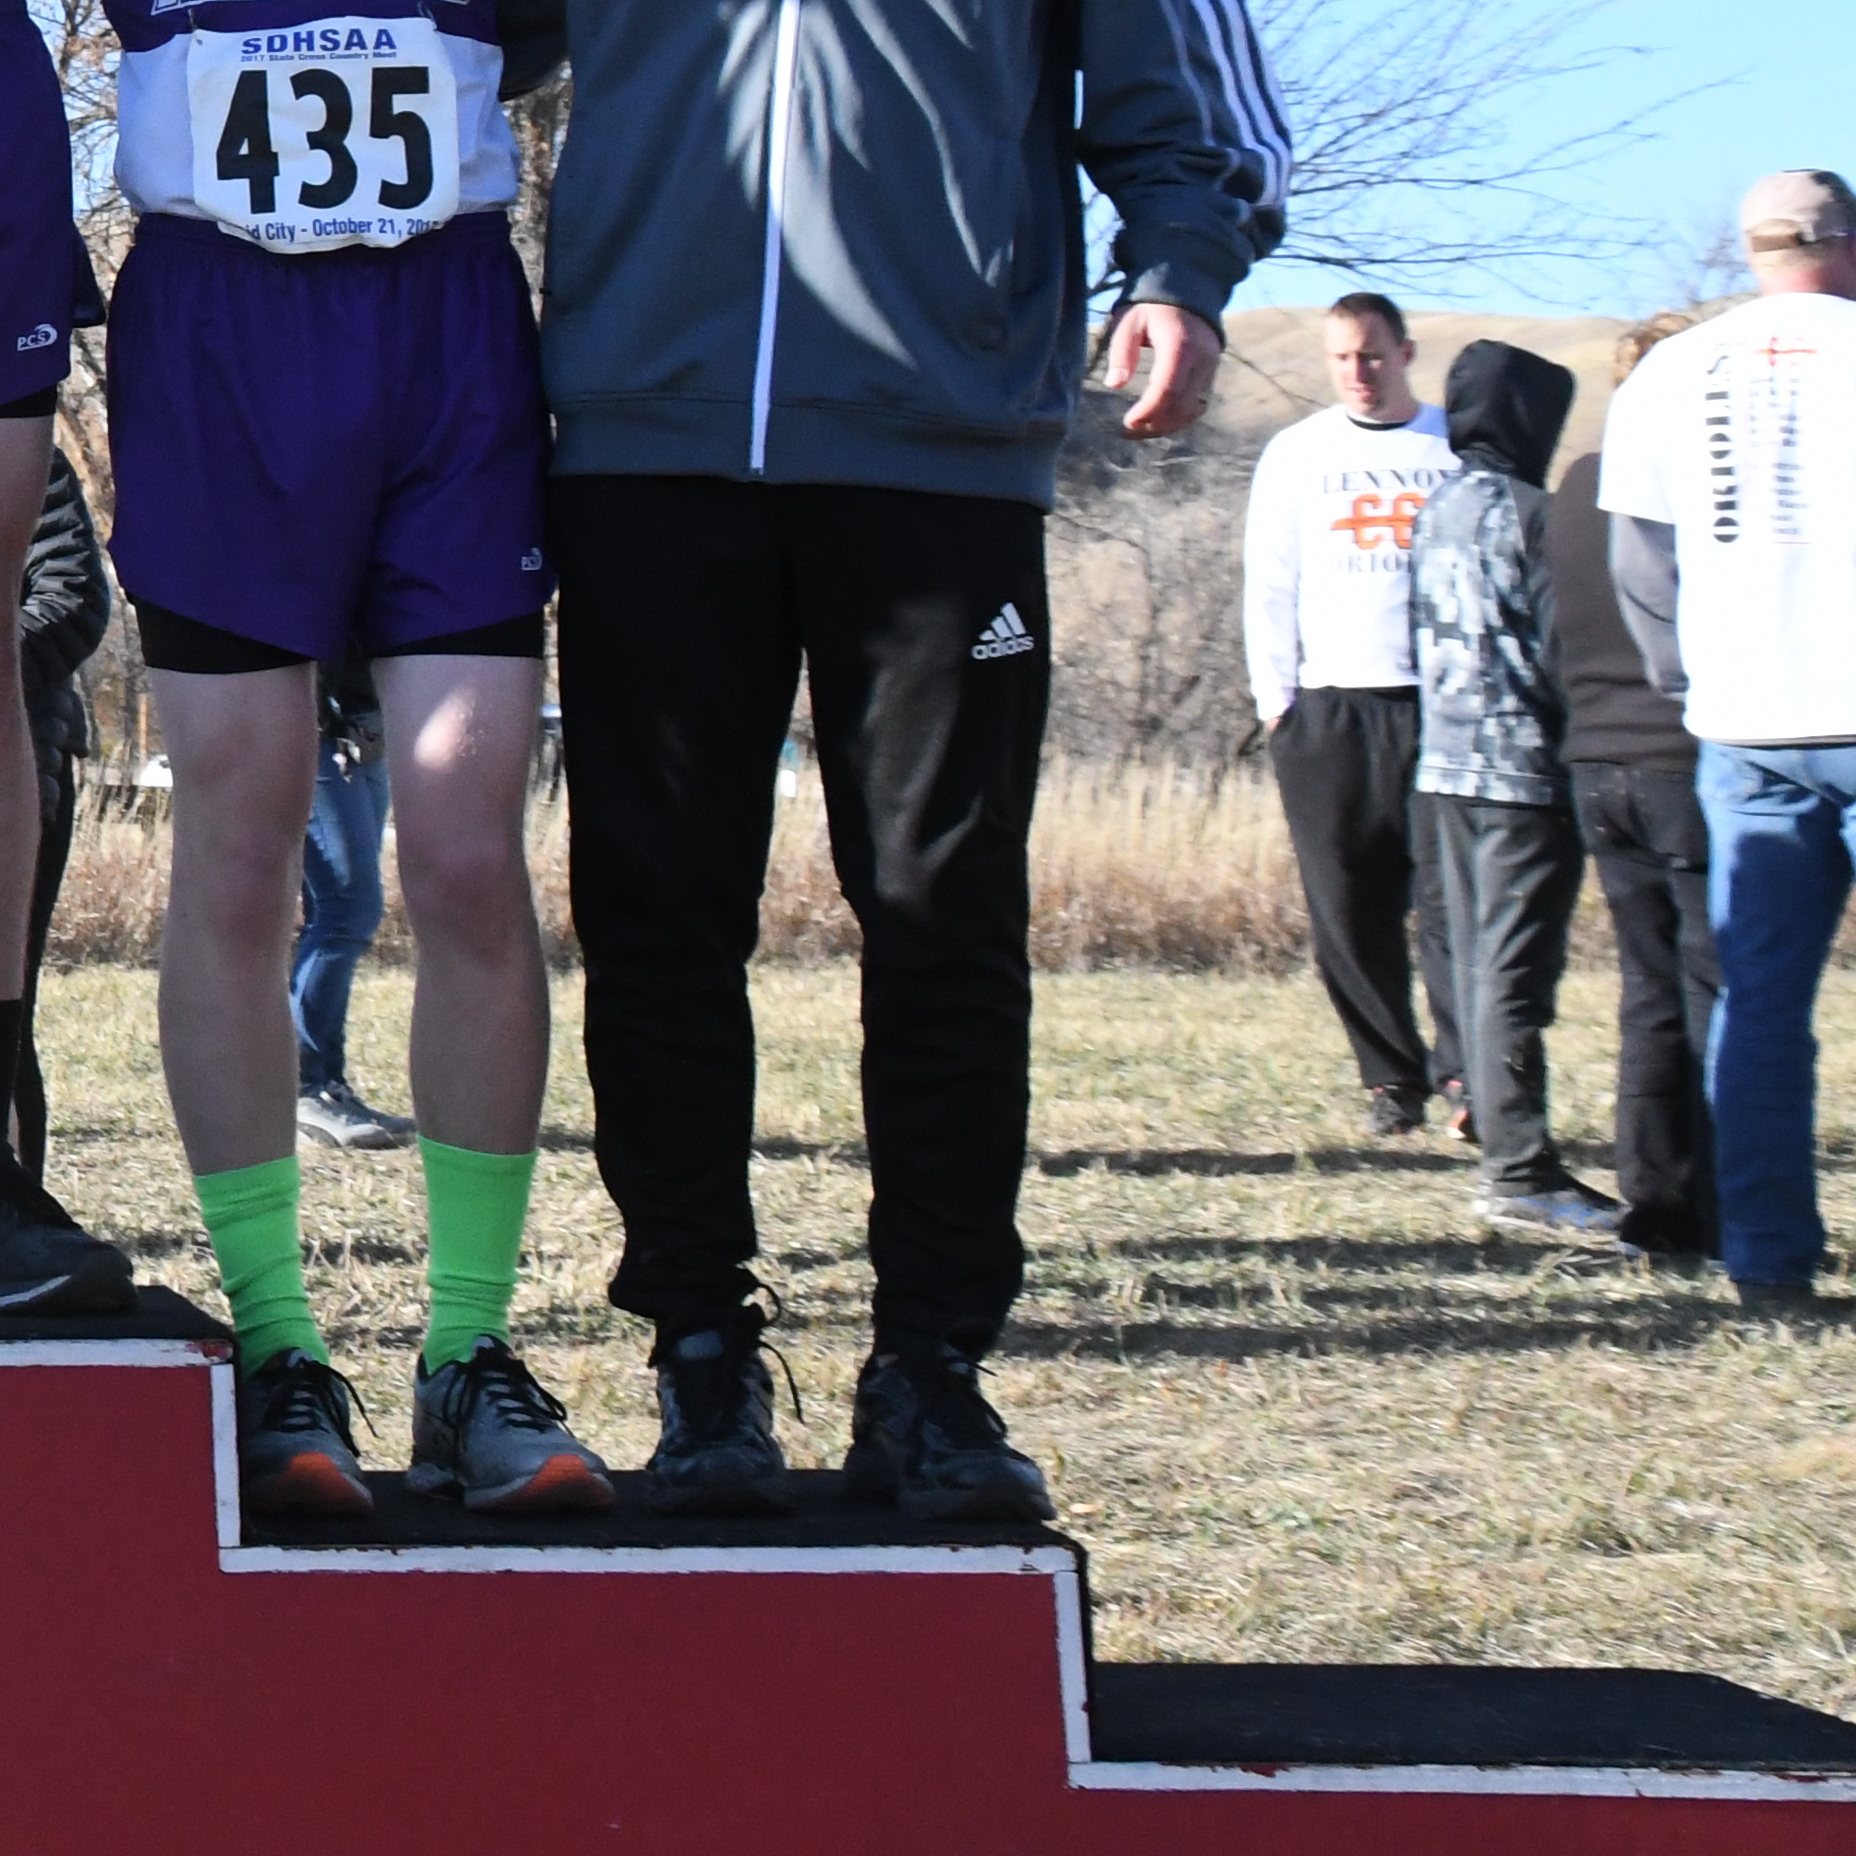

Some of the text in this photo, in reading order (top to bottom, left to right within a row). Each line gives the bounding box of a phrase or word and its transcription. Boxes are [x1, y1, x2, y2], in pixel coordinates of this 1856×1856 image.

[241, 28, 397, 54] SDHSAA
[216, 65, 434, 214] 435
[265, 222, 296, 243] City
[312, 217, 372, 236] October
[377, 218, 402, 238] 21,
[1705, 355, 1739, 543] ORIOLES
